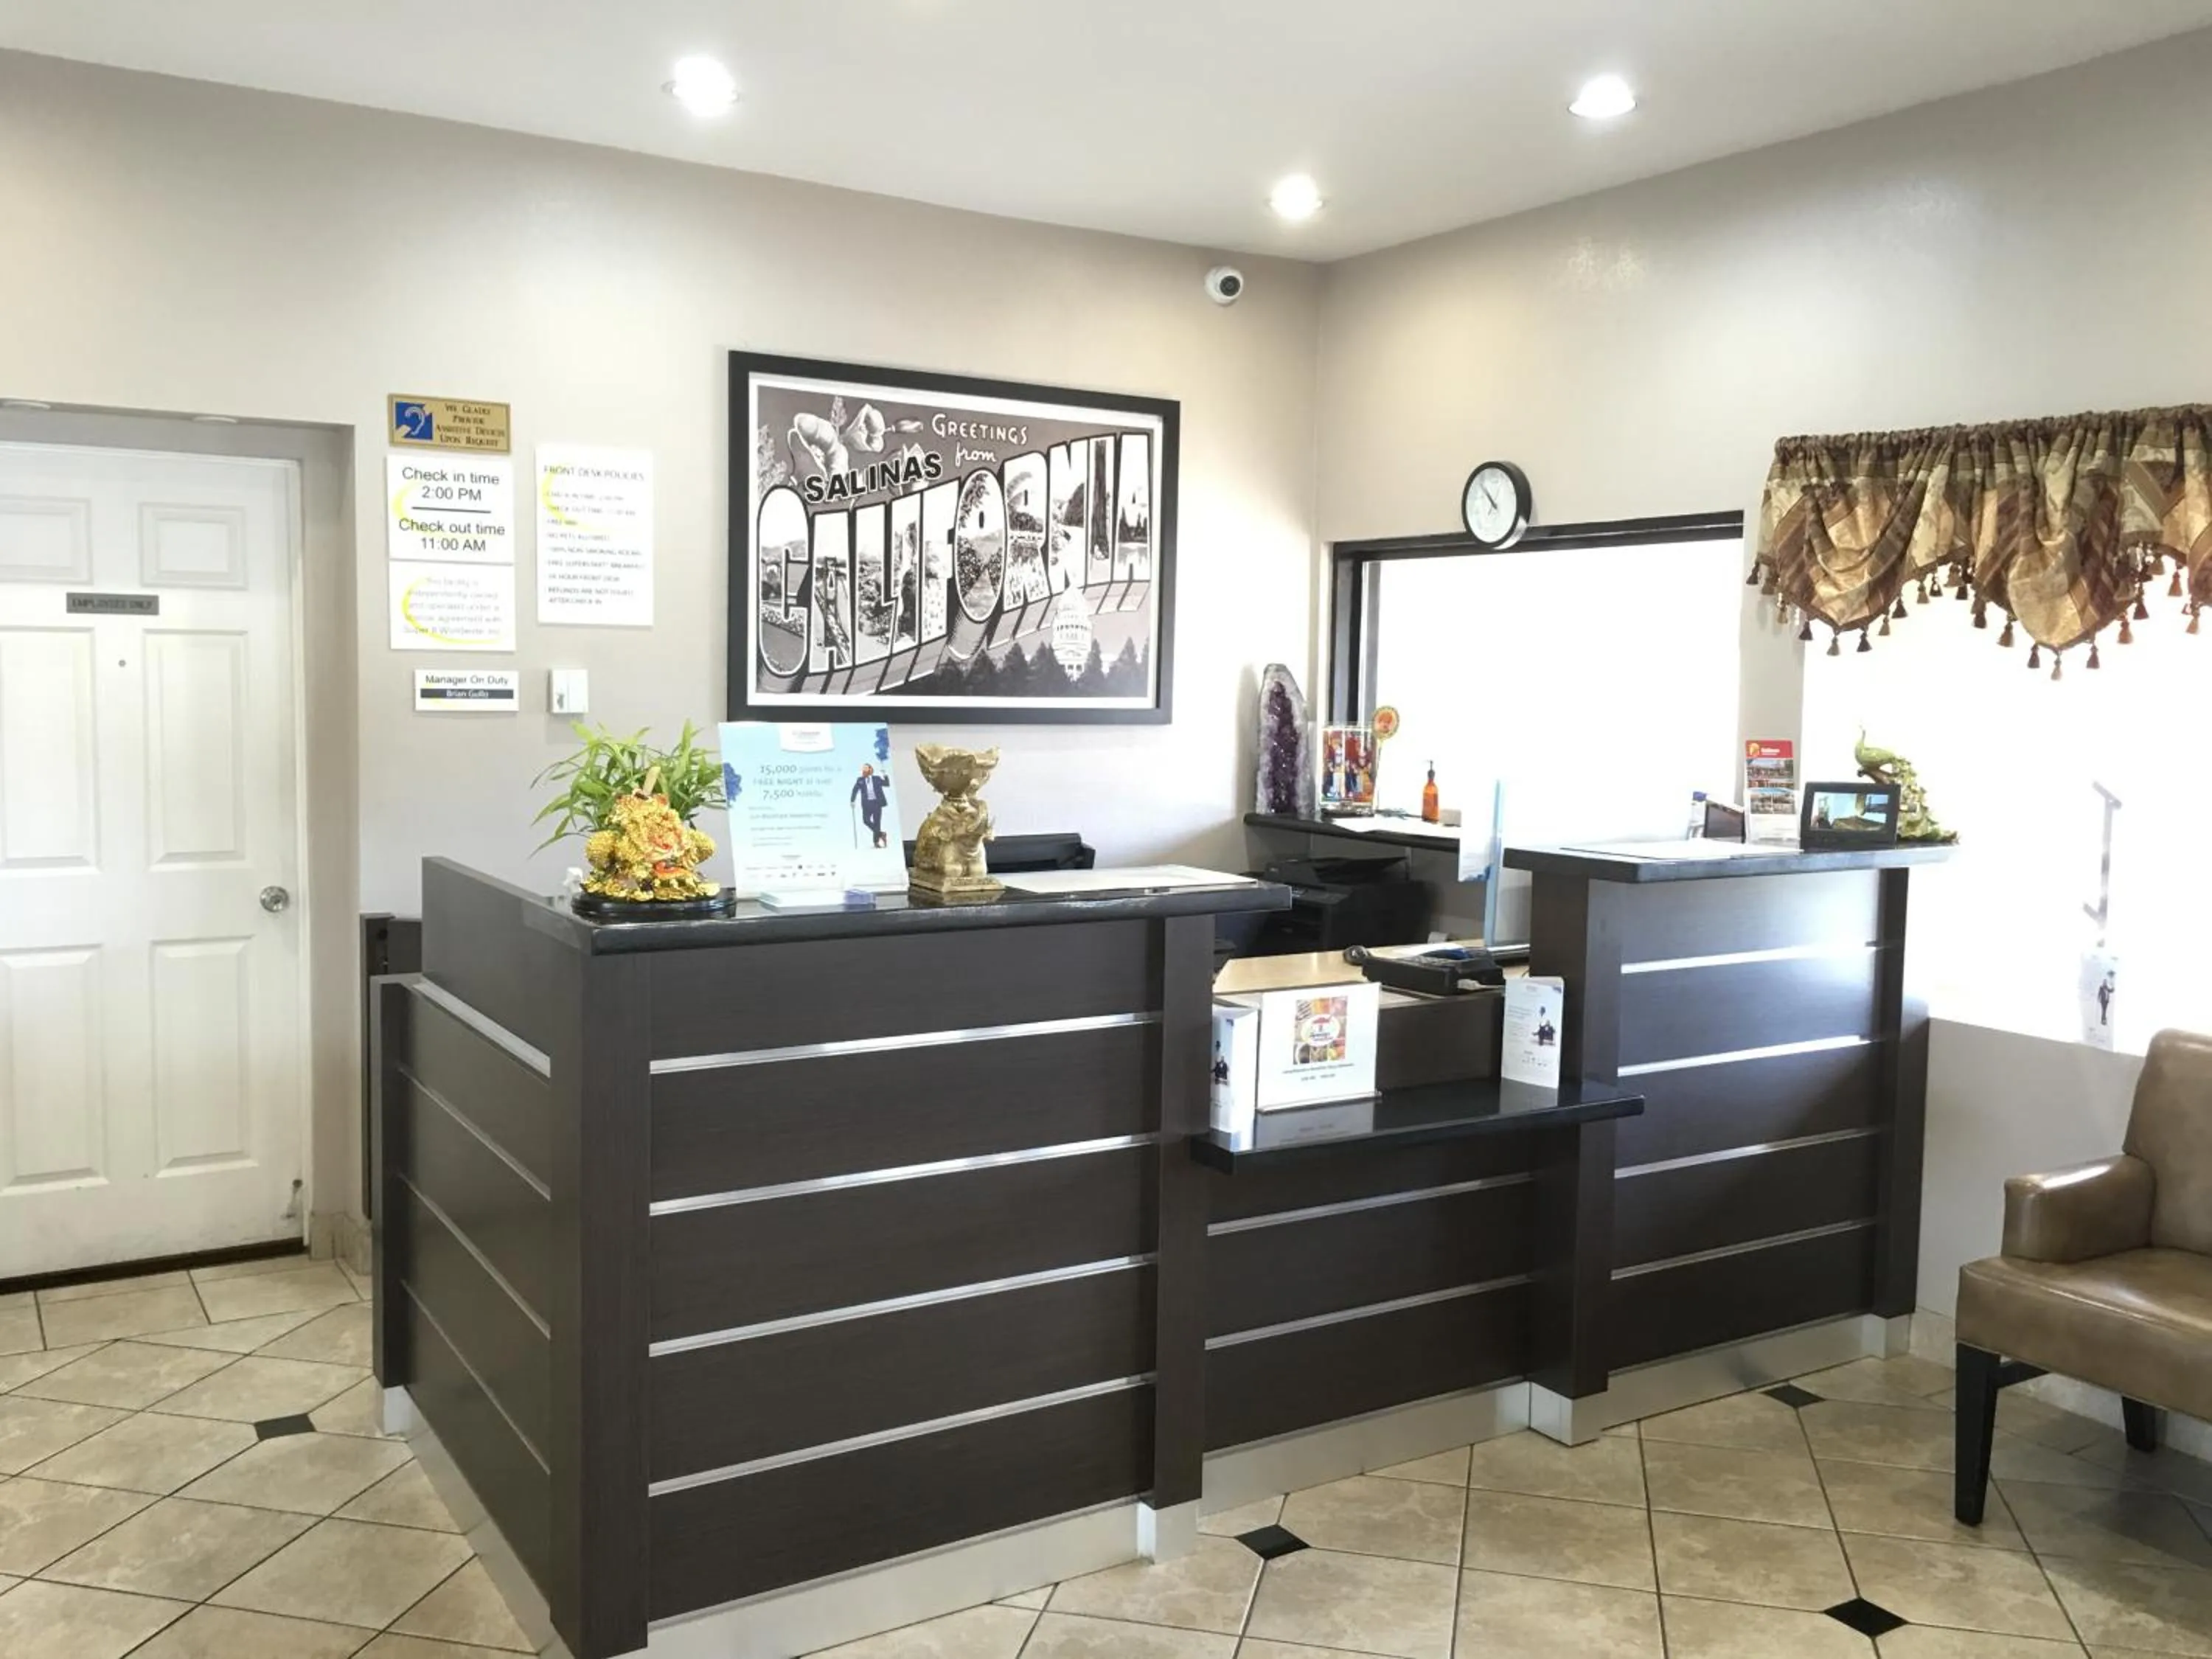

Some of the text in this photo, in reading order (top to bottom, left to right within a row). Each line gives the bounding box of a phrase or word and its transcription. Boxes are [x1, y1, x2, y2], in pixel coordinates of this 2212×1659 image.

[955, 442, 998, 467] from
[402, 466, 500, 484] Check in time
[805, 452, 943, 502] SALINAS
[421, 484, 481, 501] 2:00 PM
[399, 517, 506, 535] Check out time
[421, 537, 487, 552] 11:00 AM
[758, 432, 1152, 676] CALIFORNIA
[425, 675, 509, 686] Manager On Duty
[760, 764, 798, 776] 15,000
[762, 788, 795, 801] 7,500
